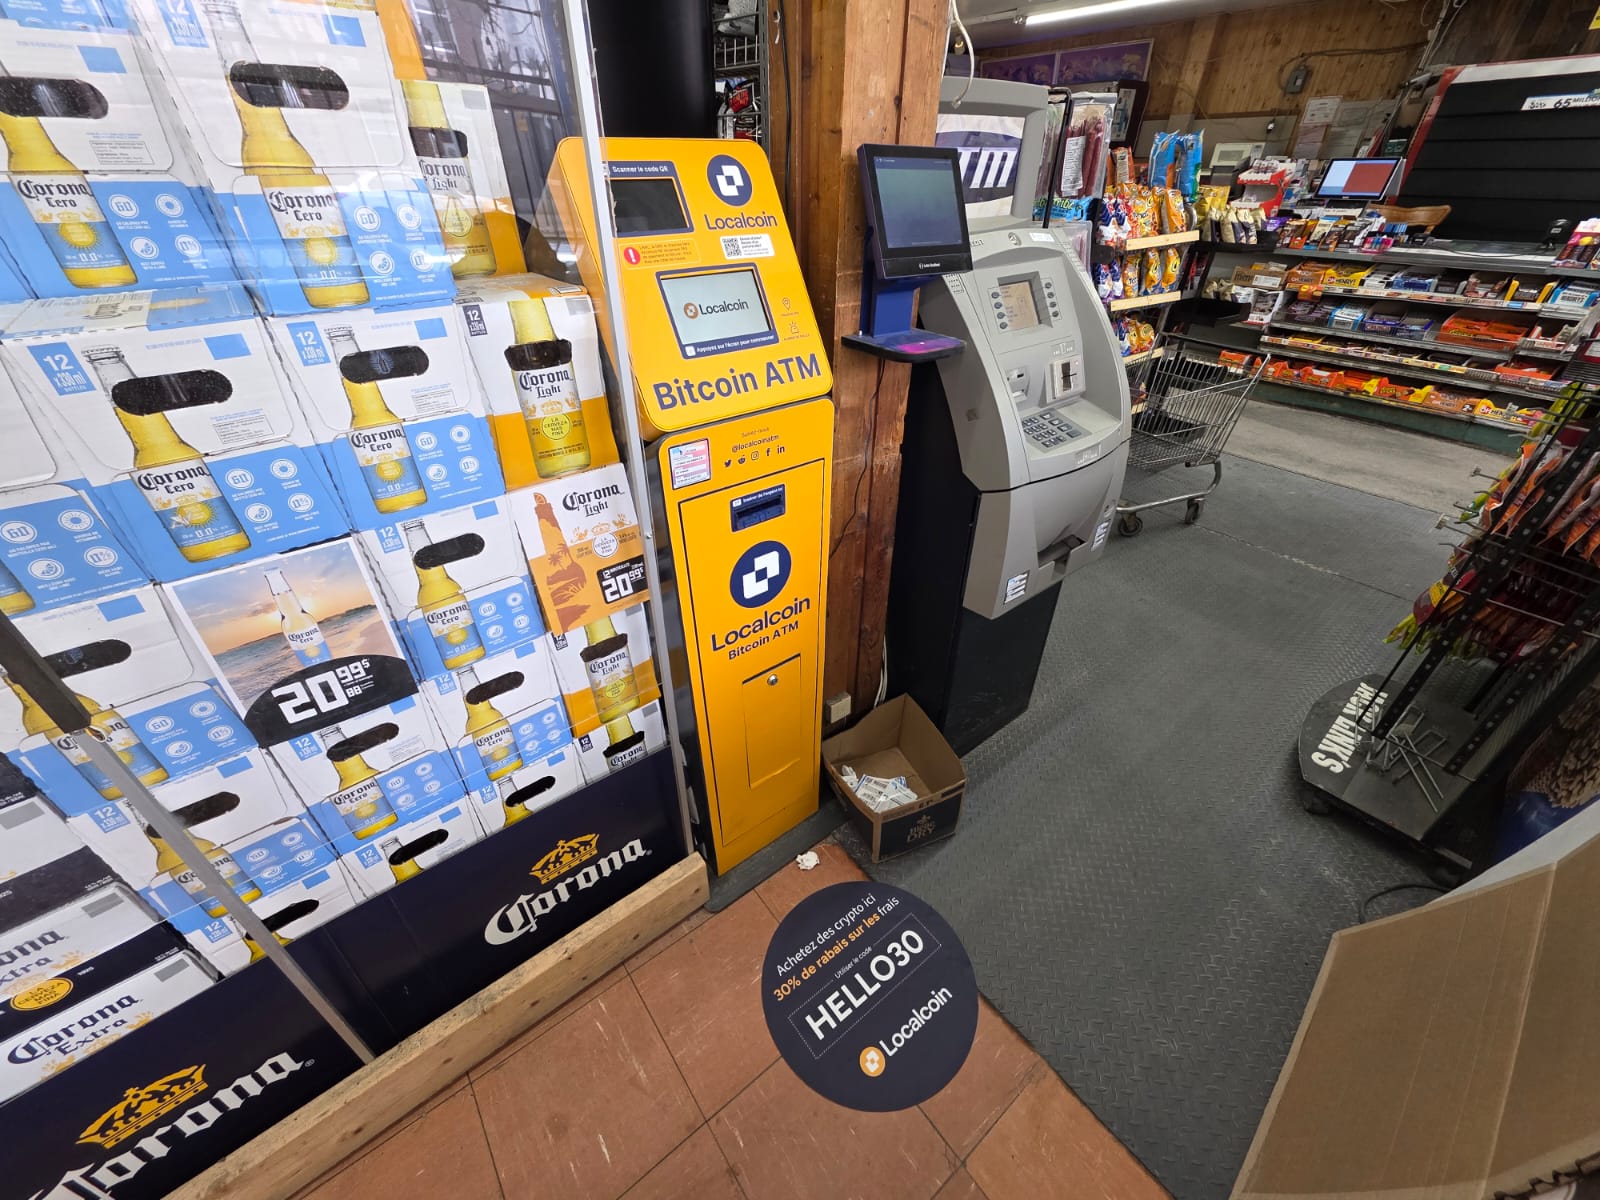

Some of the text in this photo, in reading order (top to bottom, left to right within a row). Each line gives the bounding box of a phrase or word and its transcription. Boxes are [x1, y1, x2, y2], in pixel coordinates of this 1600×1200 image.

[17, 178, 93, 203] Corona
[432, 177, 458, 191] Light
[47, 196, 77, 208] Cero
[269, 191, 334, 214] Corona
[294, 209, 322, 221] Cero
[704, 211, 778, 230] Localcoin
[466, 309, 481, 320] 12
[699, 299, 749, 316] Localcoin
[296, 331, 317, 345] 12
[43, 354, 75, 371] 12
[519, 369, 573, 392] Corona
[653, 353, 822, 411] Bitcoin ATM
[536, 386, 562, 398] Light
[351, 428, 406, 449] Corona
[370, 441, 393, 452] Cero
[732, 434, 780, 453] @localcoinatm
[138, 464, 212, 492] Corona
[165, 482, 195, 495] Cero
[562, 482, 626, 512] Corona
[585, 501, 610, 517] Light
[378, 526, 395, 540] 12
[602, 572, 634, 603] 20
[427, 602, 470, 626] Corona
[441, 614, 461, 627] Cero
[288, 627, 320, 642] Corona
[712, 597, 811, 653] Localcoin
[728, 620, 799, 660] Bitcoin ATM
[589, 651, 628, 675] Corona
[600, 663, 621, 677] Light
[437, 674, 451, 685] 12
[271, 670, 350, 725] 20
[294, 736, 312, 749] 12
[476, 726, 513, 748] Corona
[1311, 714, 1367, 774] LINK'S
[610, 745, 644, 768] Corona
[333, 780, 379, 807] Corona
[482, 785, 494, 795] 12
[95, 806, 116, 820] 12
[358, 849, 375, 862] 12
[484, 838, 647, 946] Corona
[204, 922, 222, 933] 12
[776, 893, 877, 977] Achetez des crypto ici
[773, 896, 901, 1002] 30% de rabais sur les frais
[834, 946, 874, 980] Utiliser le code
[805, 929, 925, 1041] HELLO30
[8, 993, 143, 1065] Corona
[879, 985, 953, 1058] Localcoin
[56, 1018, 127, 1058] Extra
